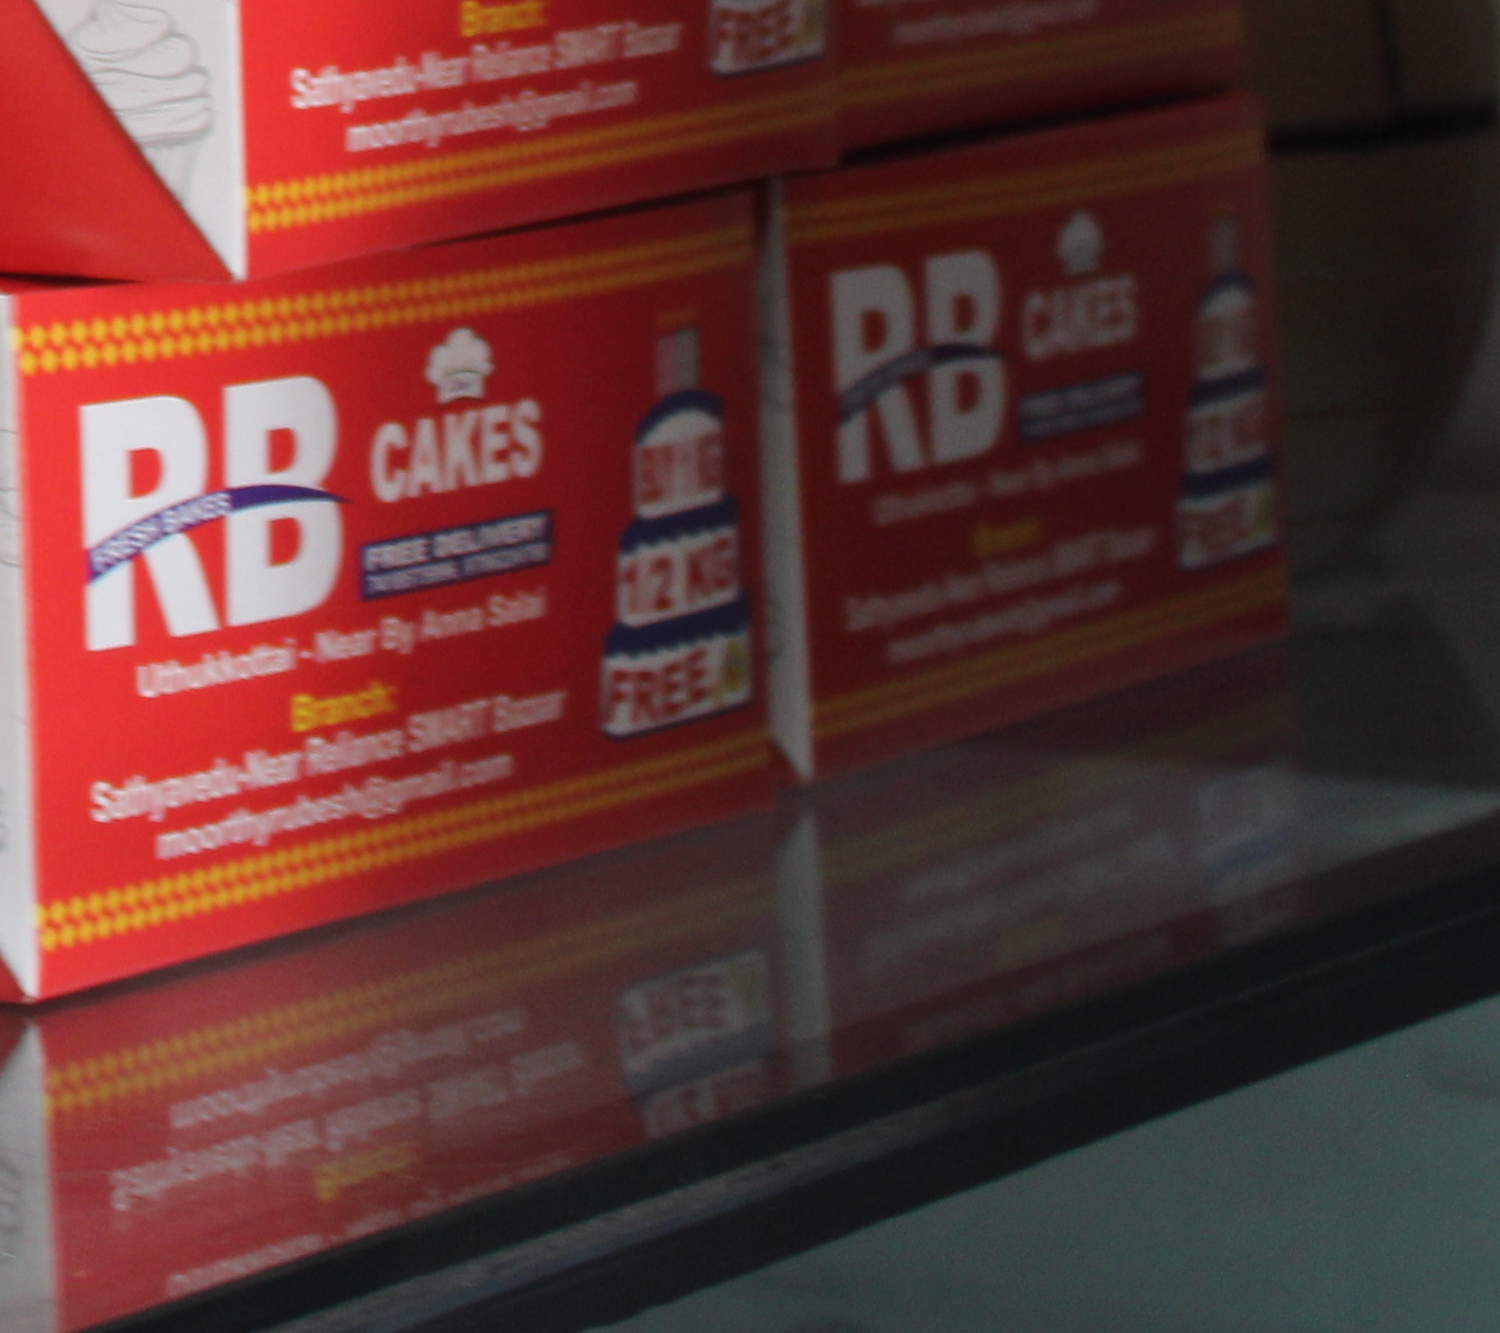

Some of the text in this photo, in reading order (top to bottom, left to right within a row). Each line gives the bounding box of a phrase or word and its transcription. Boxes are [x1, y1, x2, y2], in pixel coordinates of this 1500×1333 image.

[368, 397, 543, 503] CAKES
[829, 248, 1009, 485] RB
[79, 374, 346, 652] RB
[604, 643, 711, 731] FREE
